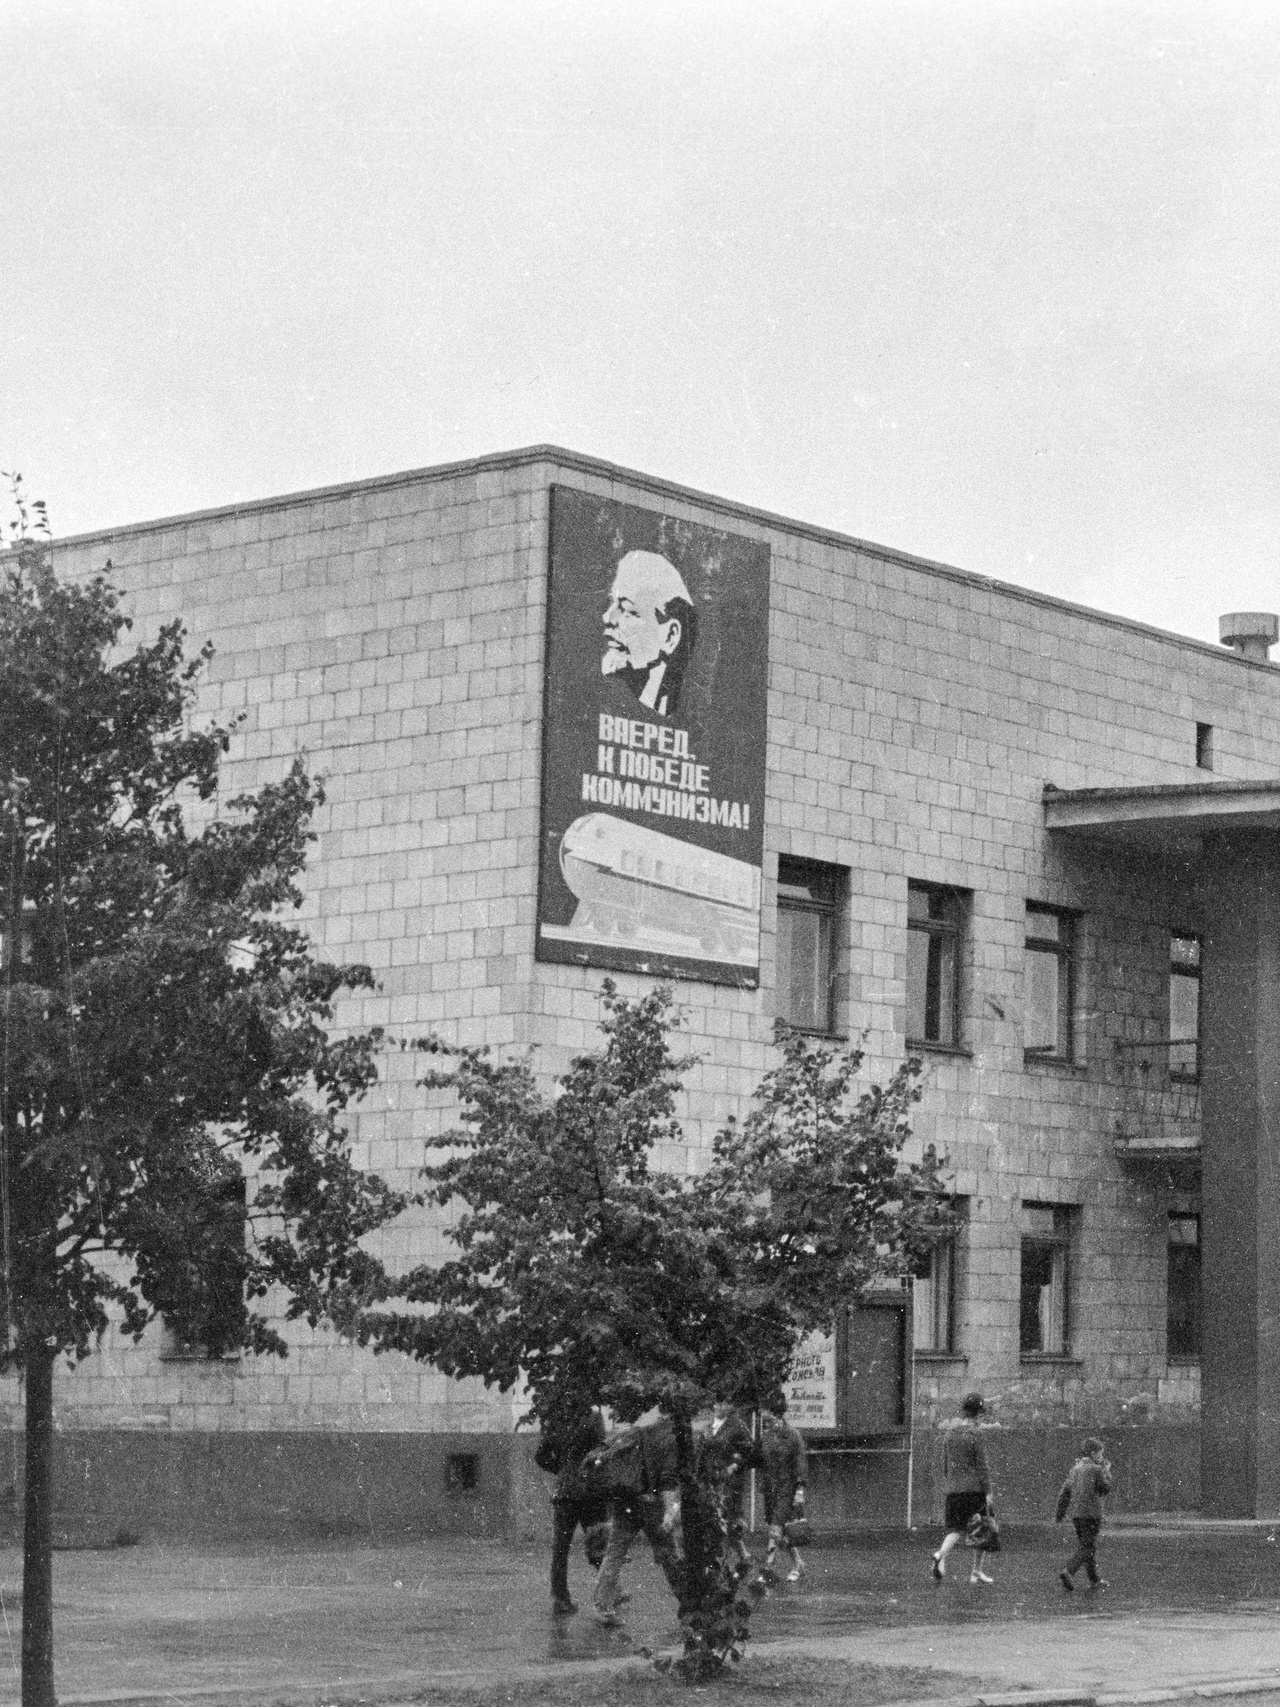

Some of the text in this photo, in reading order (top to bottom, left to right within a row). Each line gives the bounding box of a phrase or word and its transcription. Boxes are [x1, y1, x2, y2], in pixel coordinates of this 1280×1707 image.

[597, 743, 711, 793] К ПОБЕДЕ
[581, 773, 751, 830] КОММУНИЗМА!
